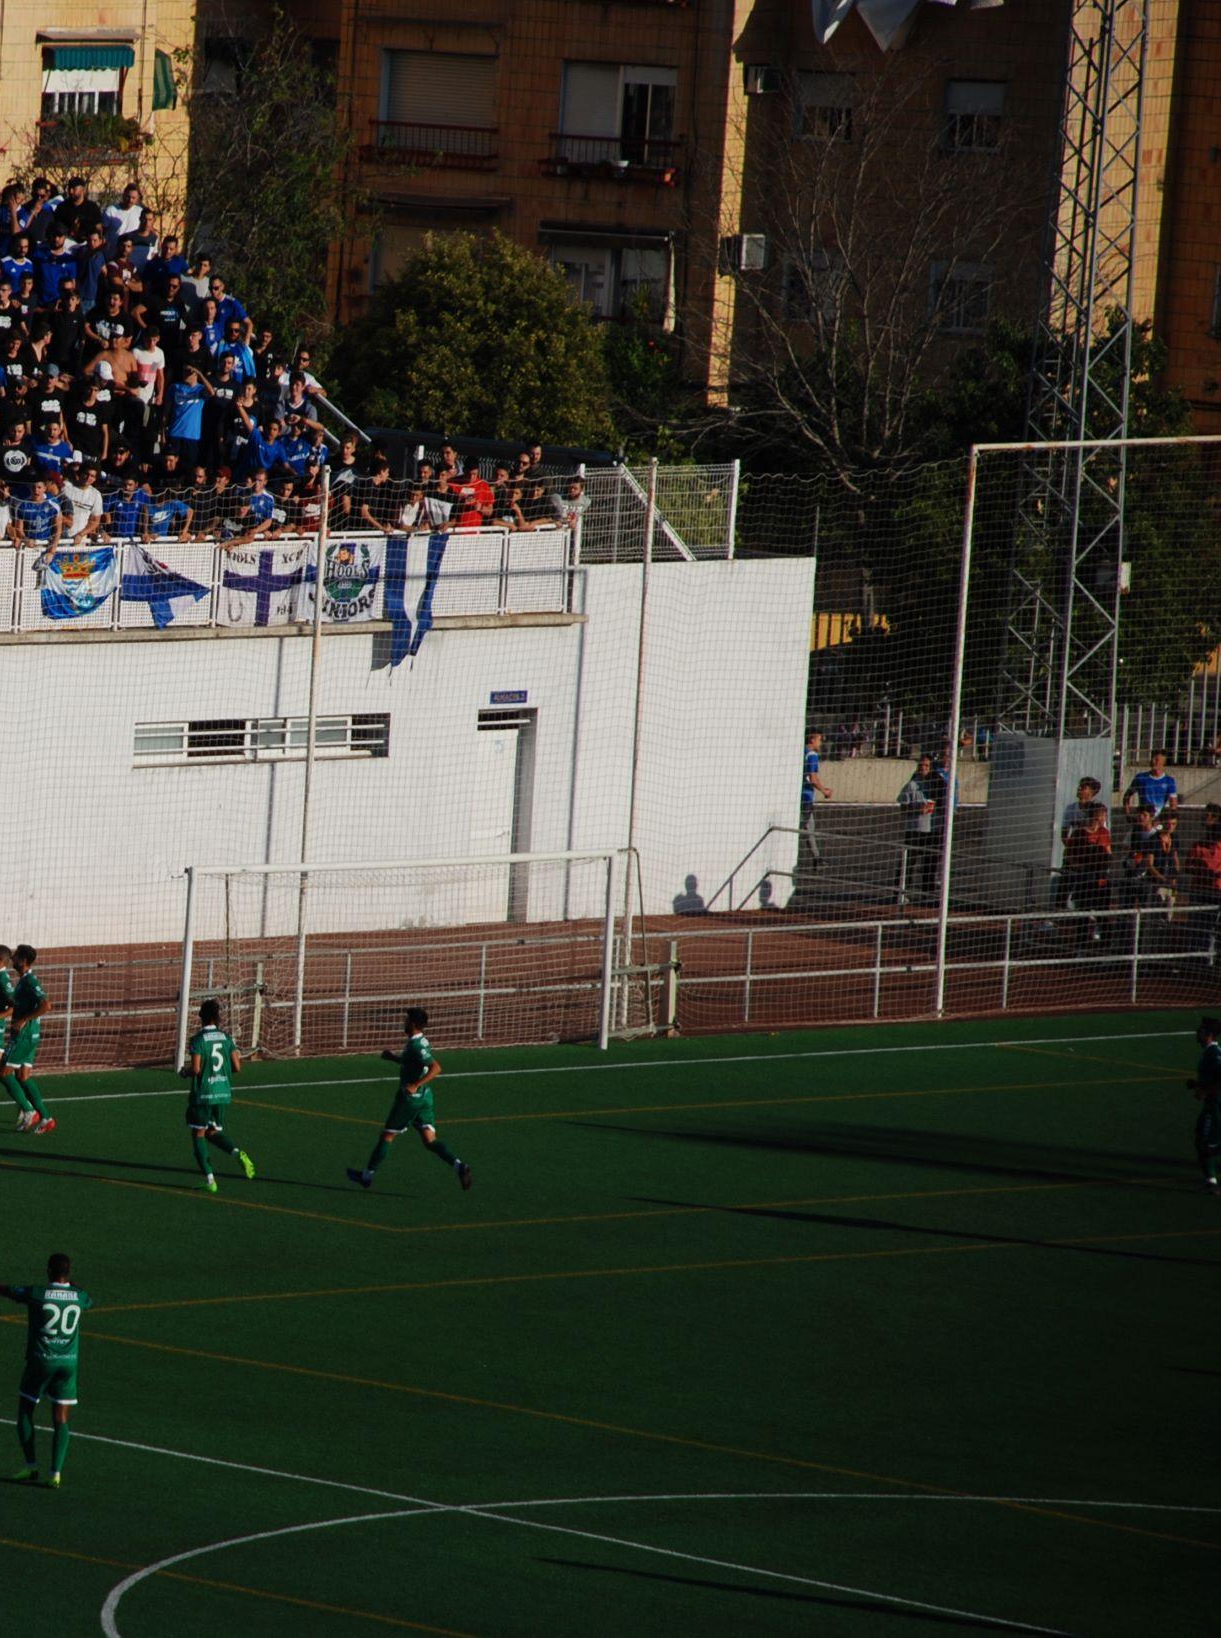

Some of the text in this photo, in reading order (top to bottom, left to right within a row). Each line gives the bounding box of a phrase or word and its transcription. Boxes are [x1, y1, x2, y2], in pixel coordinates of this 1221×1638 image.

[325, 557, 371, 580] HOOLS
[211, 1043, 225, 1072] 5
[42, 1303, 81, 1335] 20
